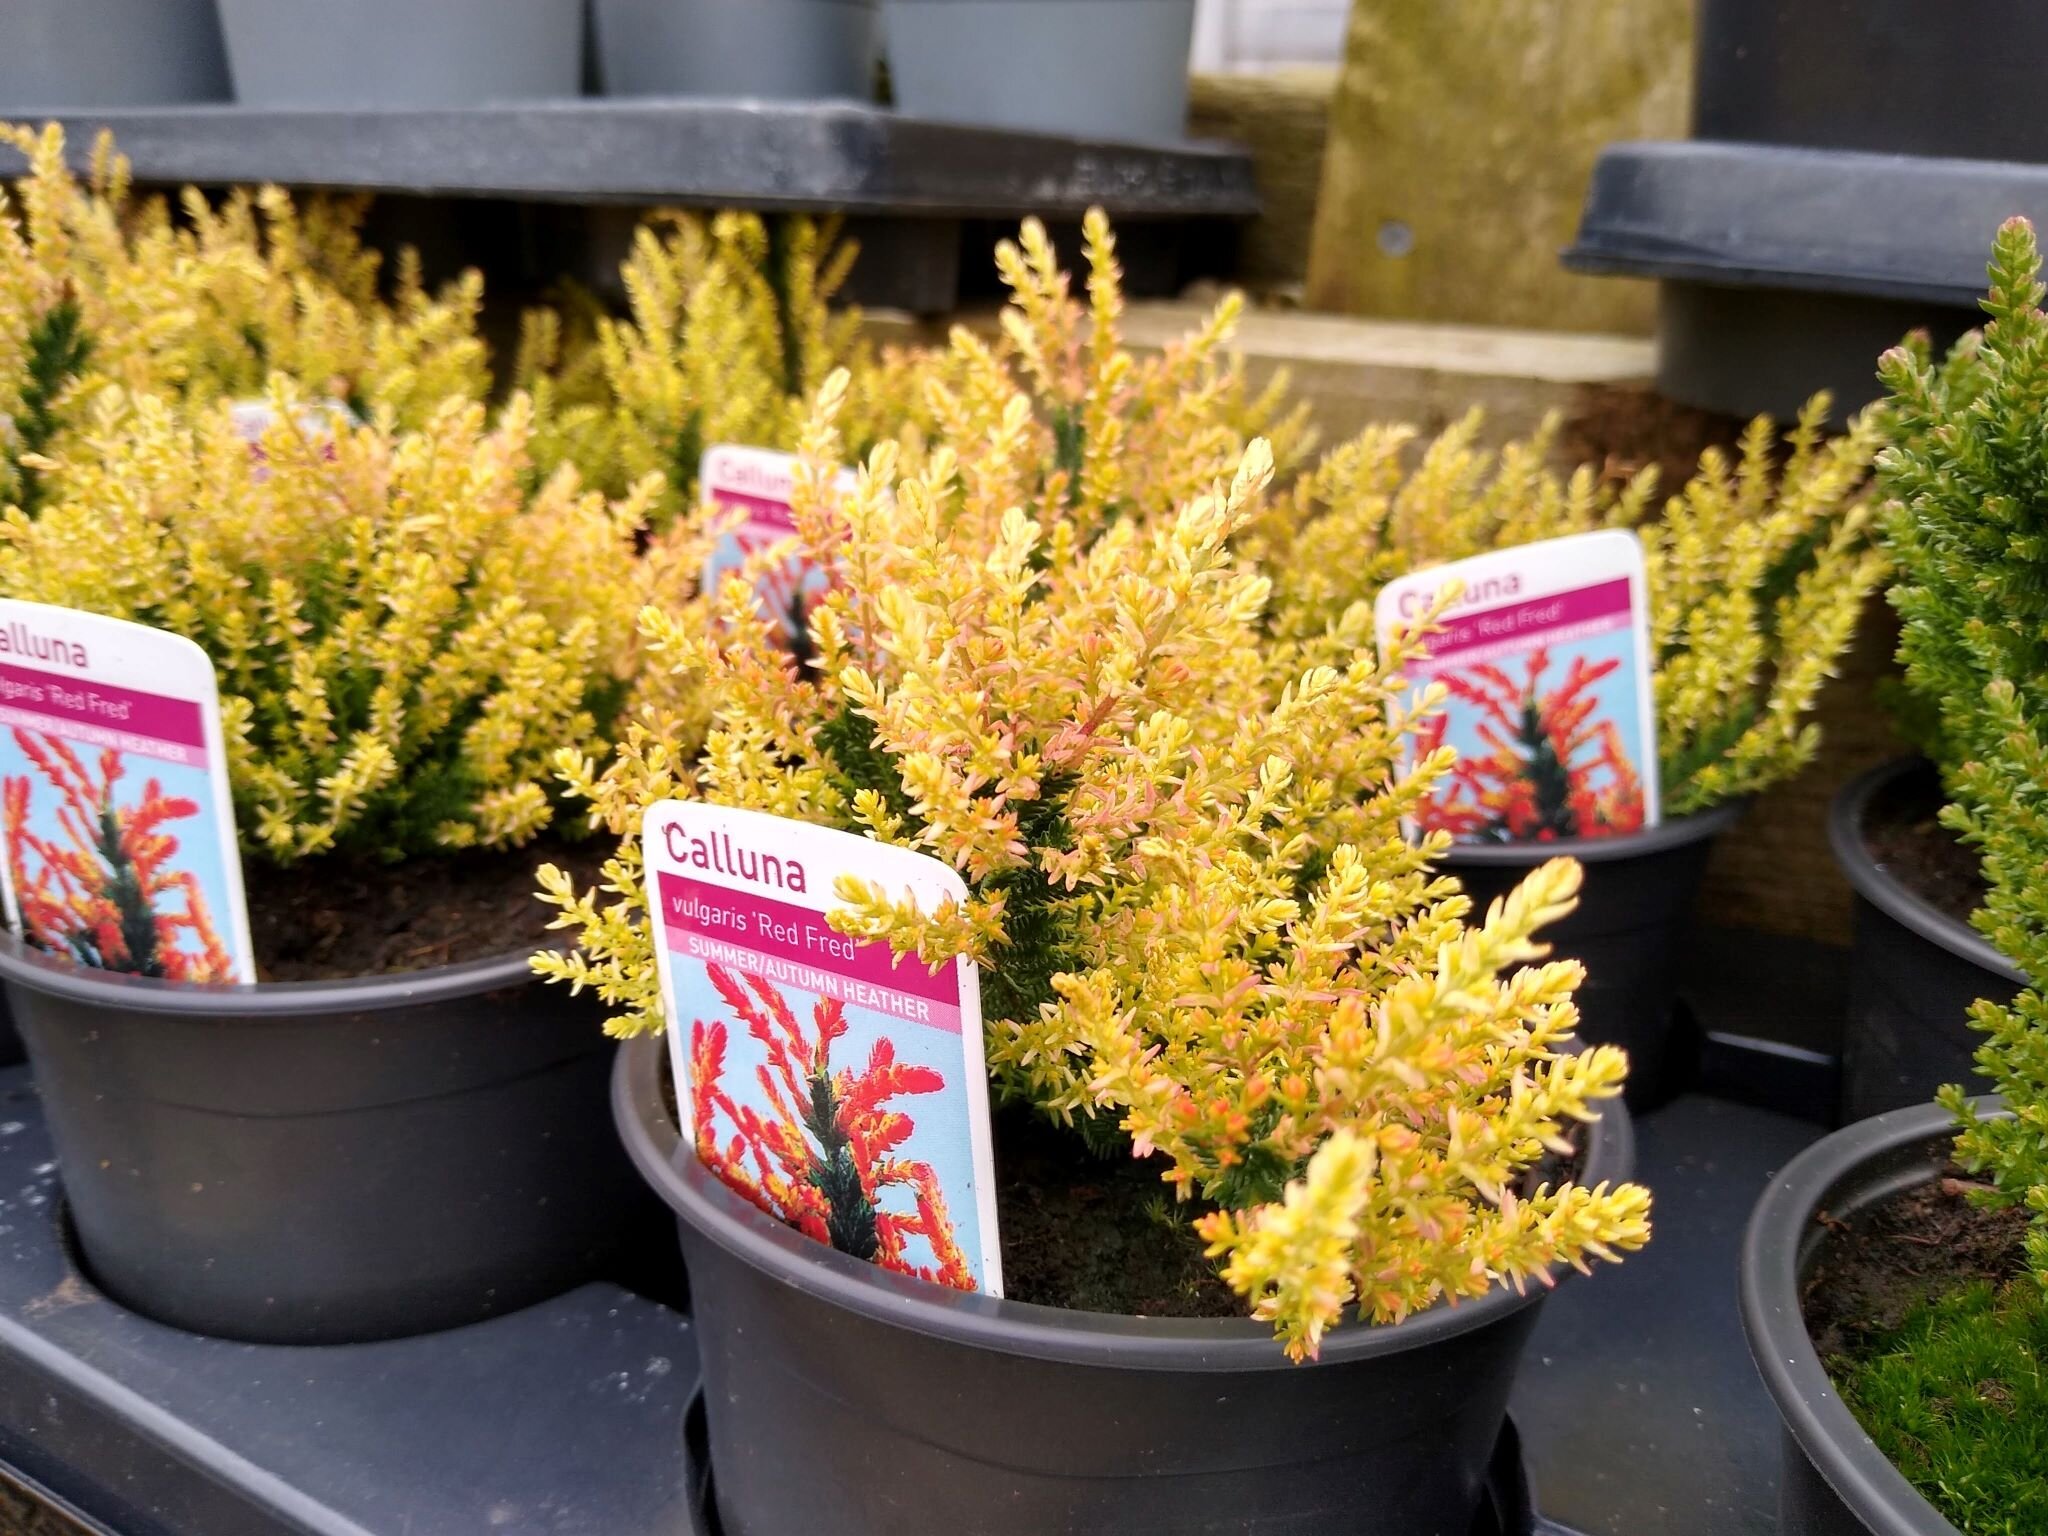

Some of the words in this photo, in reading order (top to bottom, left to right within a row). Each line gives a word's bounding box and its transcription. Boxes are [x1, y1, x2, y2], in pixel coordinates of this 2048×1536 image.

[719, 458, 793, 490] Callun
[1399, 573, 1520, 618] Cauna
[0, 622, 88, 668] alluna
[665, 821, 807, 894] Calluna
[672, 896, 748, 931] vulgaris
[752, 911, 799, 946] 'Red
[688, 937, 838, 995] SUMMER/AUTUMN
[843, 980, 930, 1021] HEATHER
